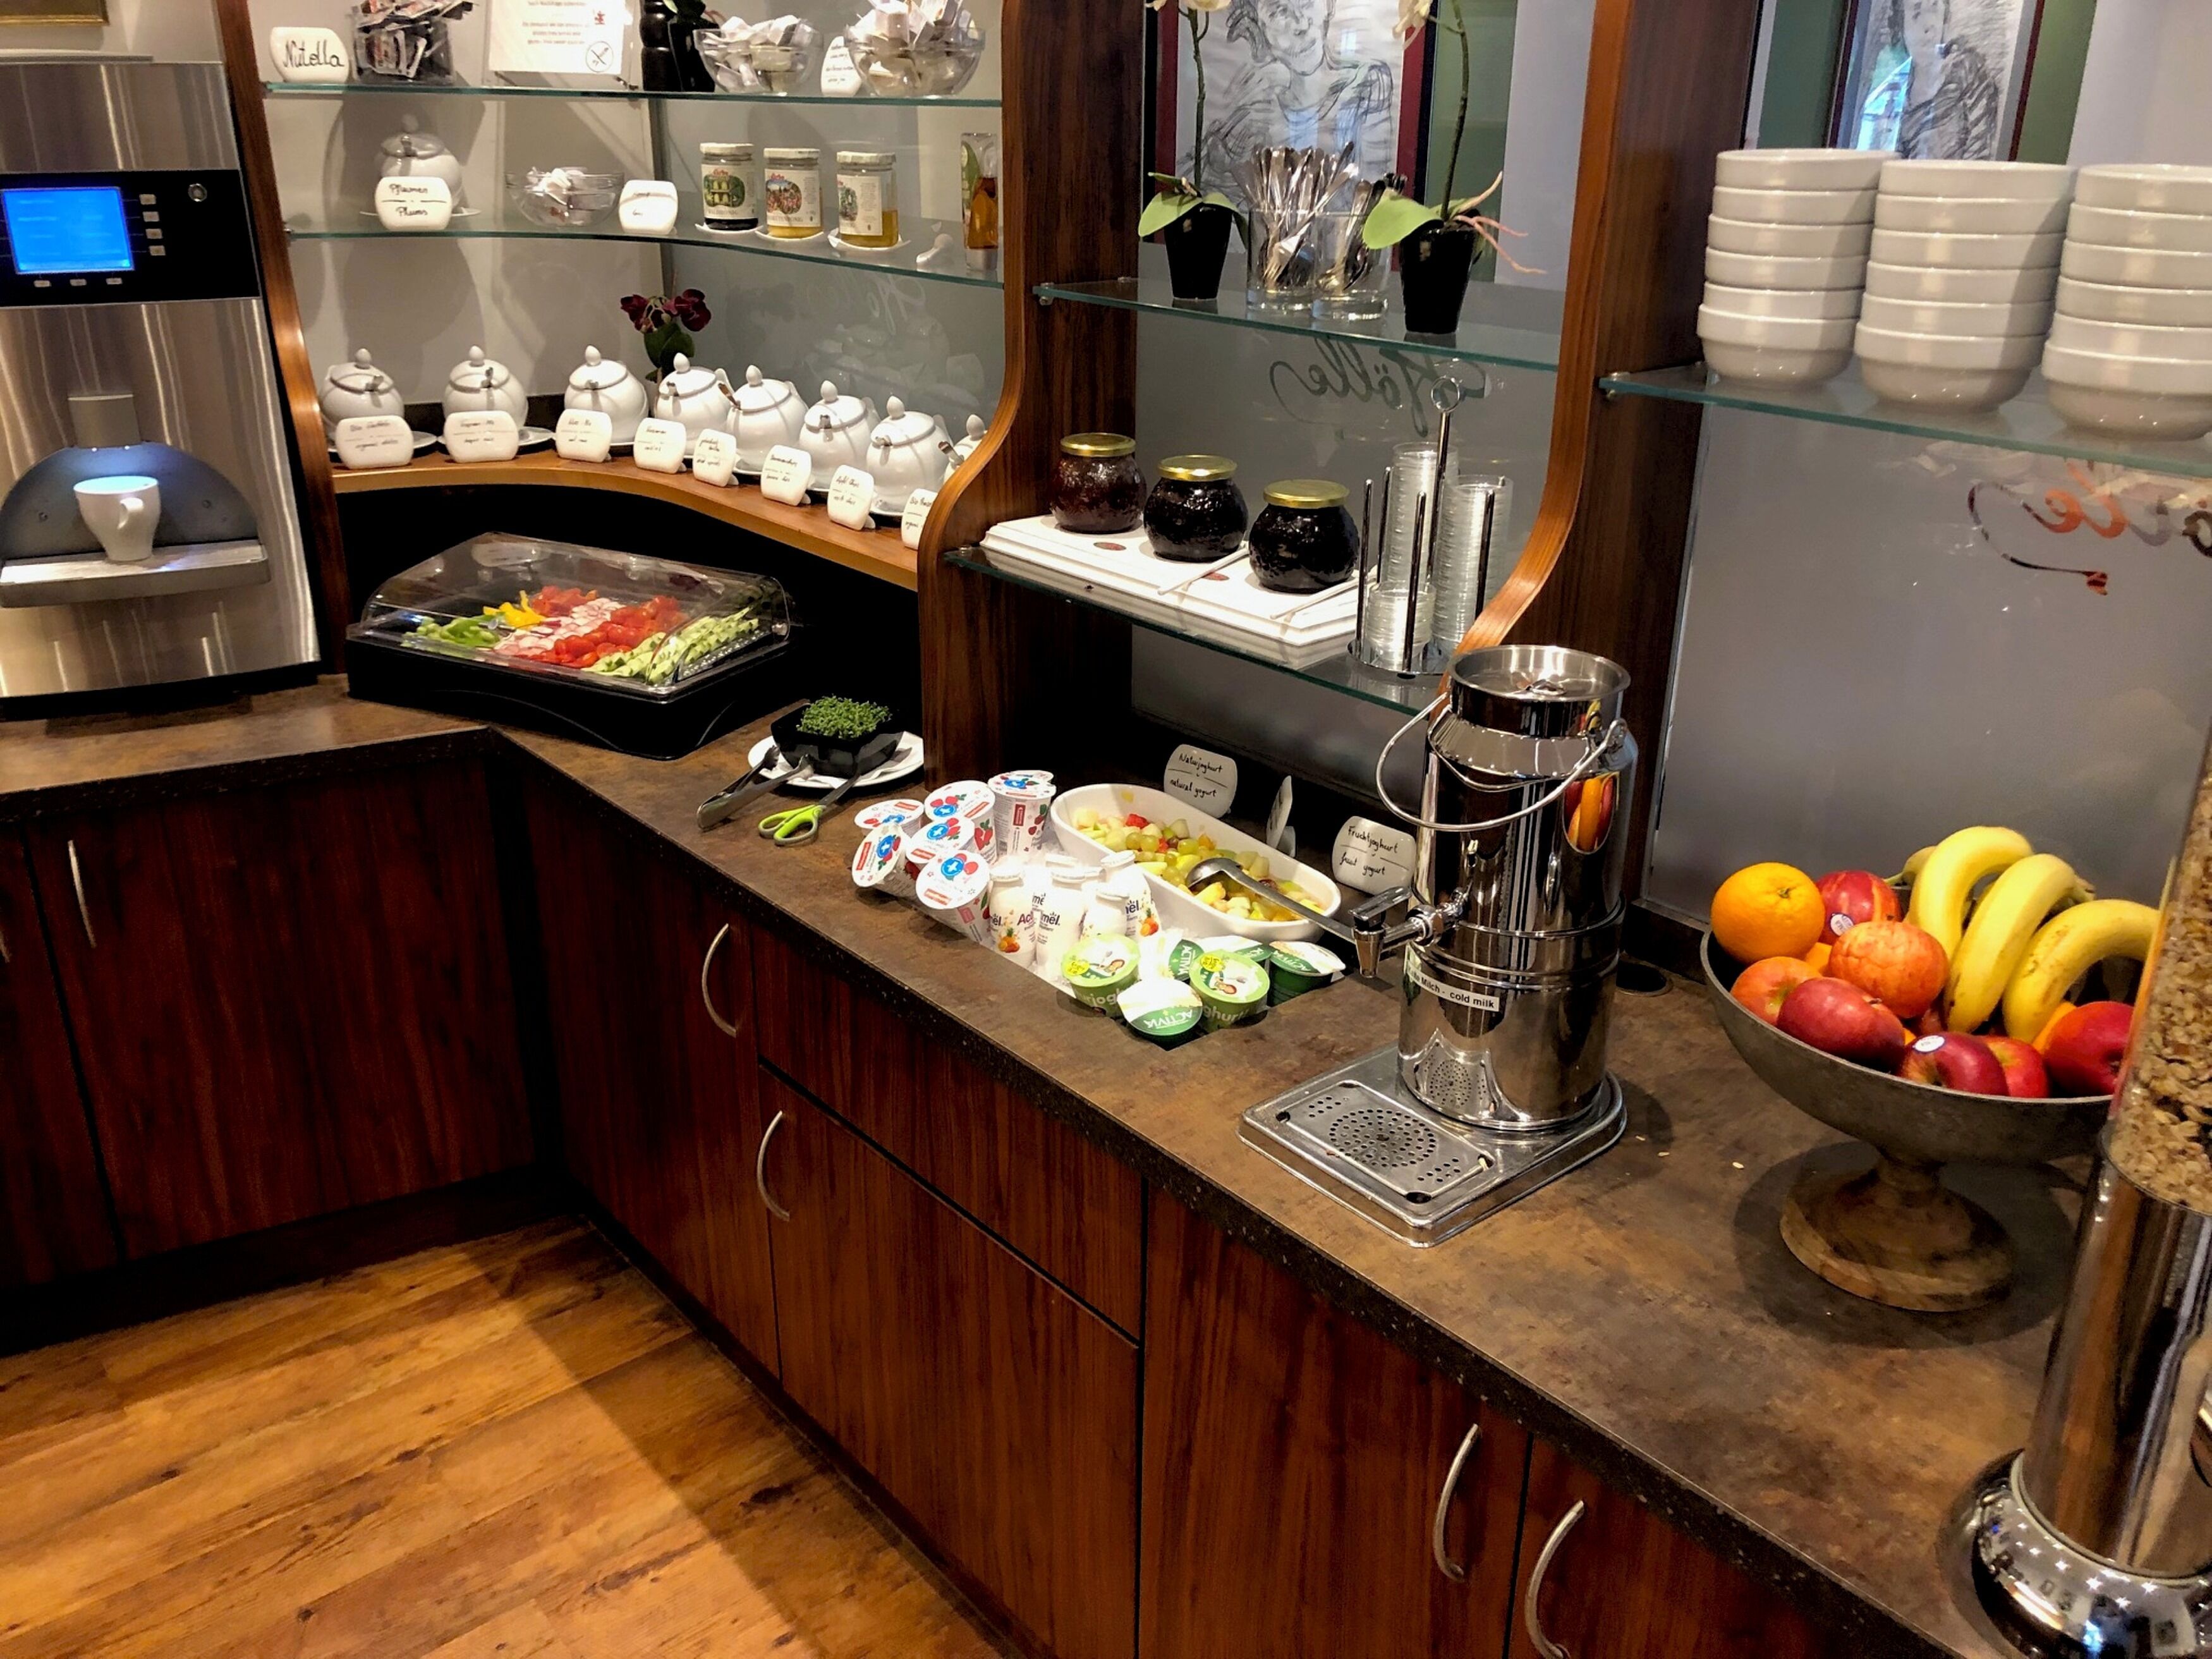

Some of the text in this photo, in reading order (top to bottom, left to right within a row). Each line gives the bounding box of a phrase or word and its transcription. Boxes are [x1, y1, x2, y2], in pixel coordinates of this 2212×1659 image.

[283, 39, 344, 68] Nutella
[389, 183, 428, 195] Pflaumen
[396, 206, 428, 216] Plums
[1179, 753, 1223, 774] Naturjoghurt
[1169, 778, 1217, 798] natural yogurt
[1347, 825, 1398, 853] Fruchtjoghurt
[1362, 865, 1385, 877] yogurt
[1421, 976, 1440, 994] Milch
[1449, 992, 1470, 1003] cold
[1473, 999, 1494, 1009] milk
[1144, 1009, 1193, 1030] ACTIVIA
